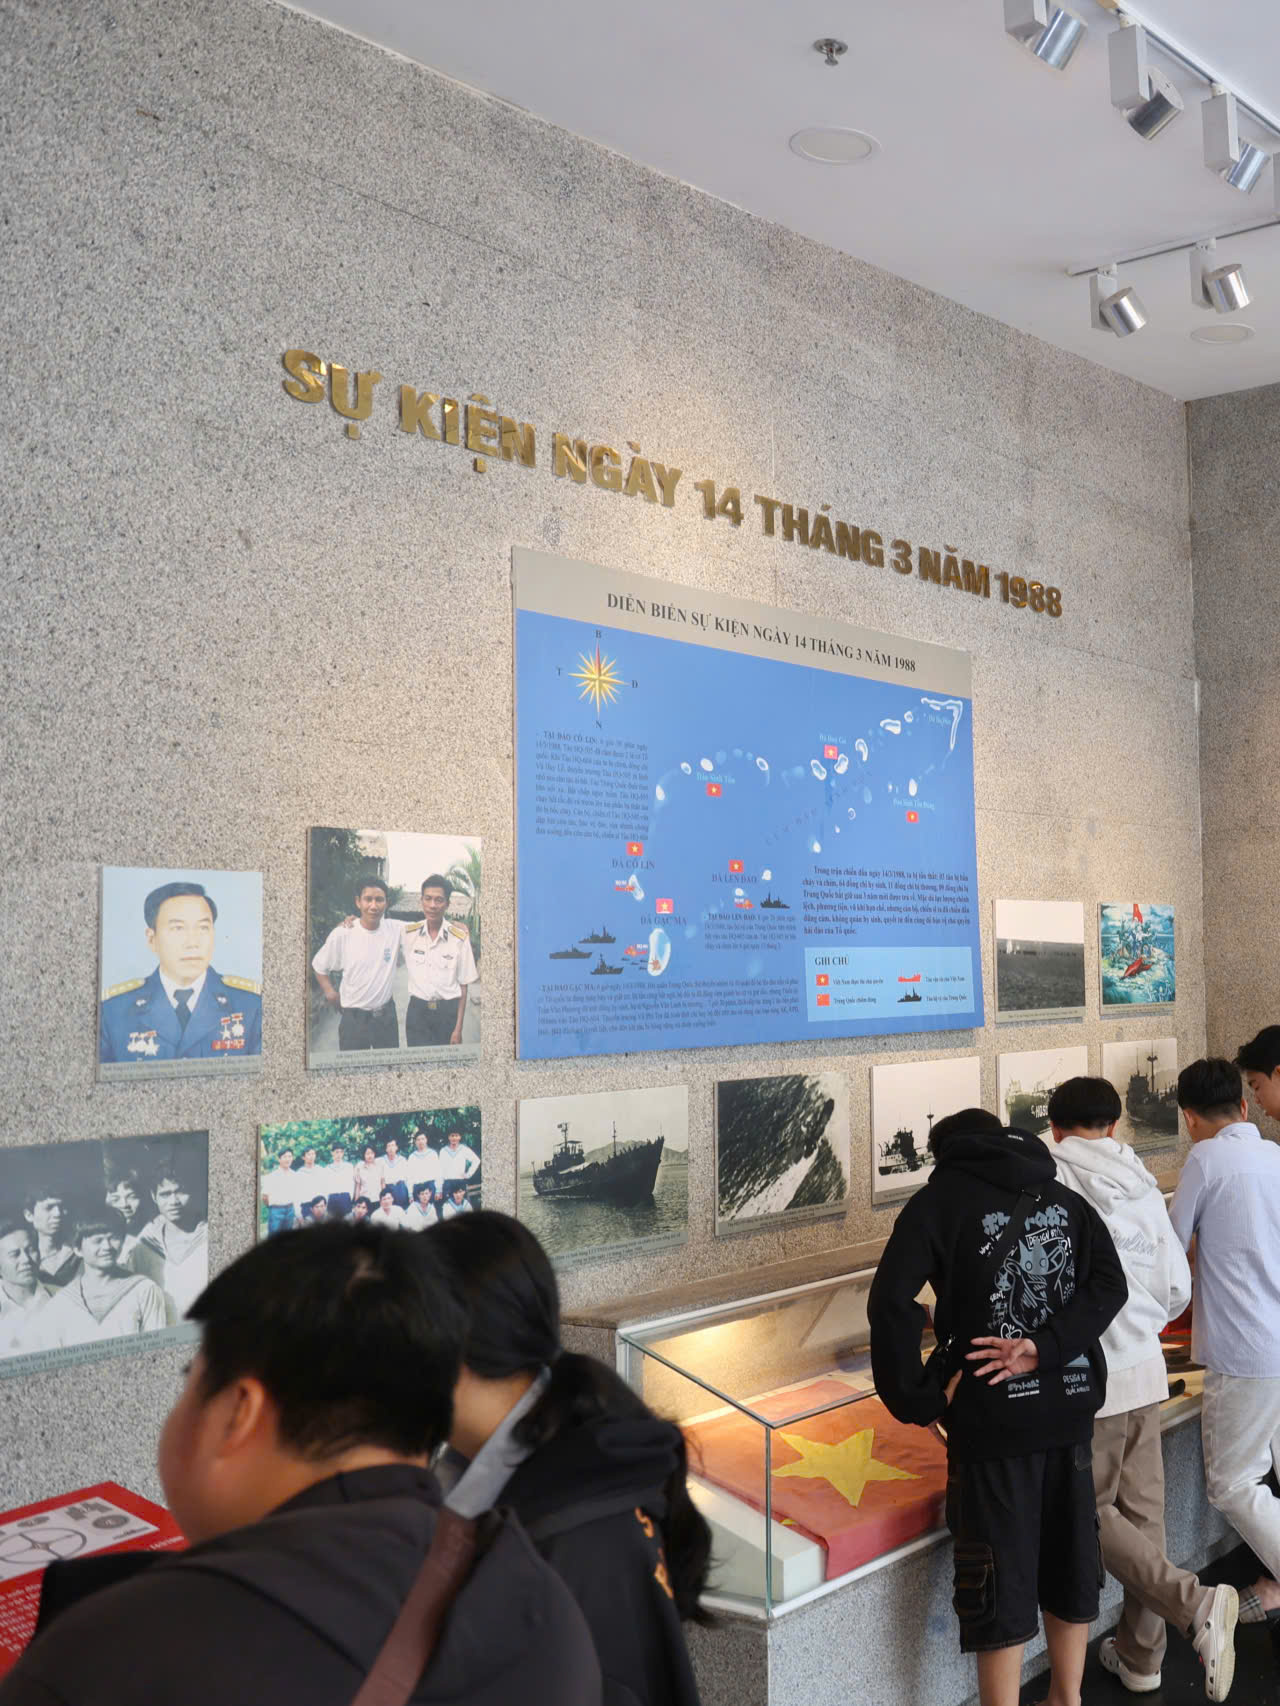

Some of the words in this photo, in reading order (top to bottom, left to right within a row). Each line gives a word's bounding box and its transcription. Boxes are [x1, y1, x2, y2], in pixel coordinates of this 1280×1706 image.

[283, 349, 384, 440] SỰ
[400, 386, 536, 473] KIỆN
[554, 432, 683, 507] NGÀY
[695, 479, 744, 527] 14
[754, 494, 884, 569] THÁNG
[889, 538, 912, 575] 3
[918, 544, 990, 598] NĂM
[994, 572, 1062, 619] 1988
[607, 592, 646, 615] DIỄN
[651, 601, 687, 623] BIẾN
[691, 611, 712, 630] SỰ
[715, 616, 749, 638] KIỆN
[753, 625, 791, 645] NGÀY
[795, 634, 807, 649] 14
[810, 637, 853, 660] THÁNG
[856, 648, 862, 661] 3
[865, 649, 892, 668] NĂM
[894, 656, 916, 673] 1988
[815, 956, 830, 965] GHI
